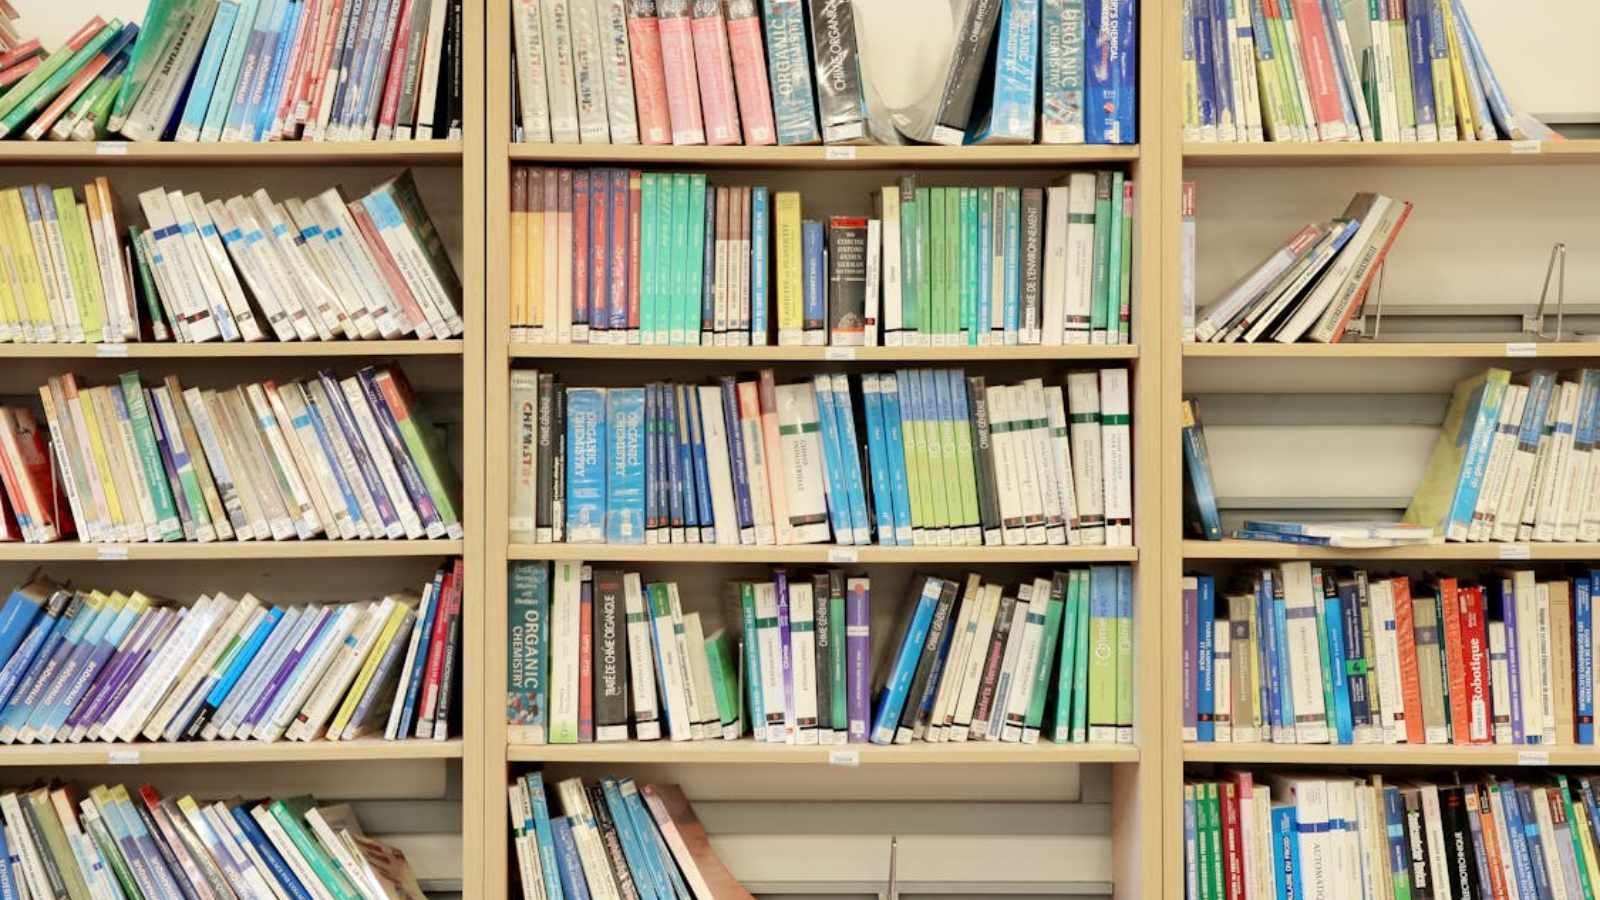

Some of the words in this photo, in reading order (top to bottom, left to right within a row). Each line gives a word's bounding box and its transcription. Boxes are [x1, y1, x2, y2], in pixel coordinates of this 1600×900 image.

[771, 18, 793, 97] ORGANIC
[1061, 8, 1081, 88] ORGANIC
[1109, 19, 1120, 61] CHEMICAL
[521, 401, 534, 487] CHEMISTRY
[511, 625, 523, 688] CHEMISTRY
[524, 609, 540, 689] ORGANIC
[1470, 637, 1485, 702] Robotique
[24, 660, 58, 704] DYNAMIQUE
[43, 660, 77, 705] DYNAMIQUE
[63, 660, 97, 706] DYNAMIQUE
